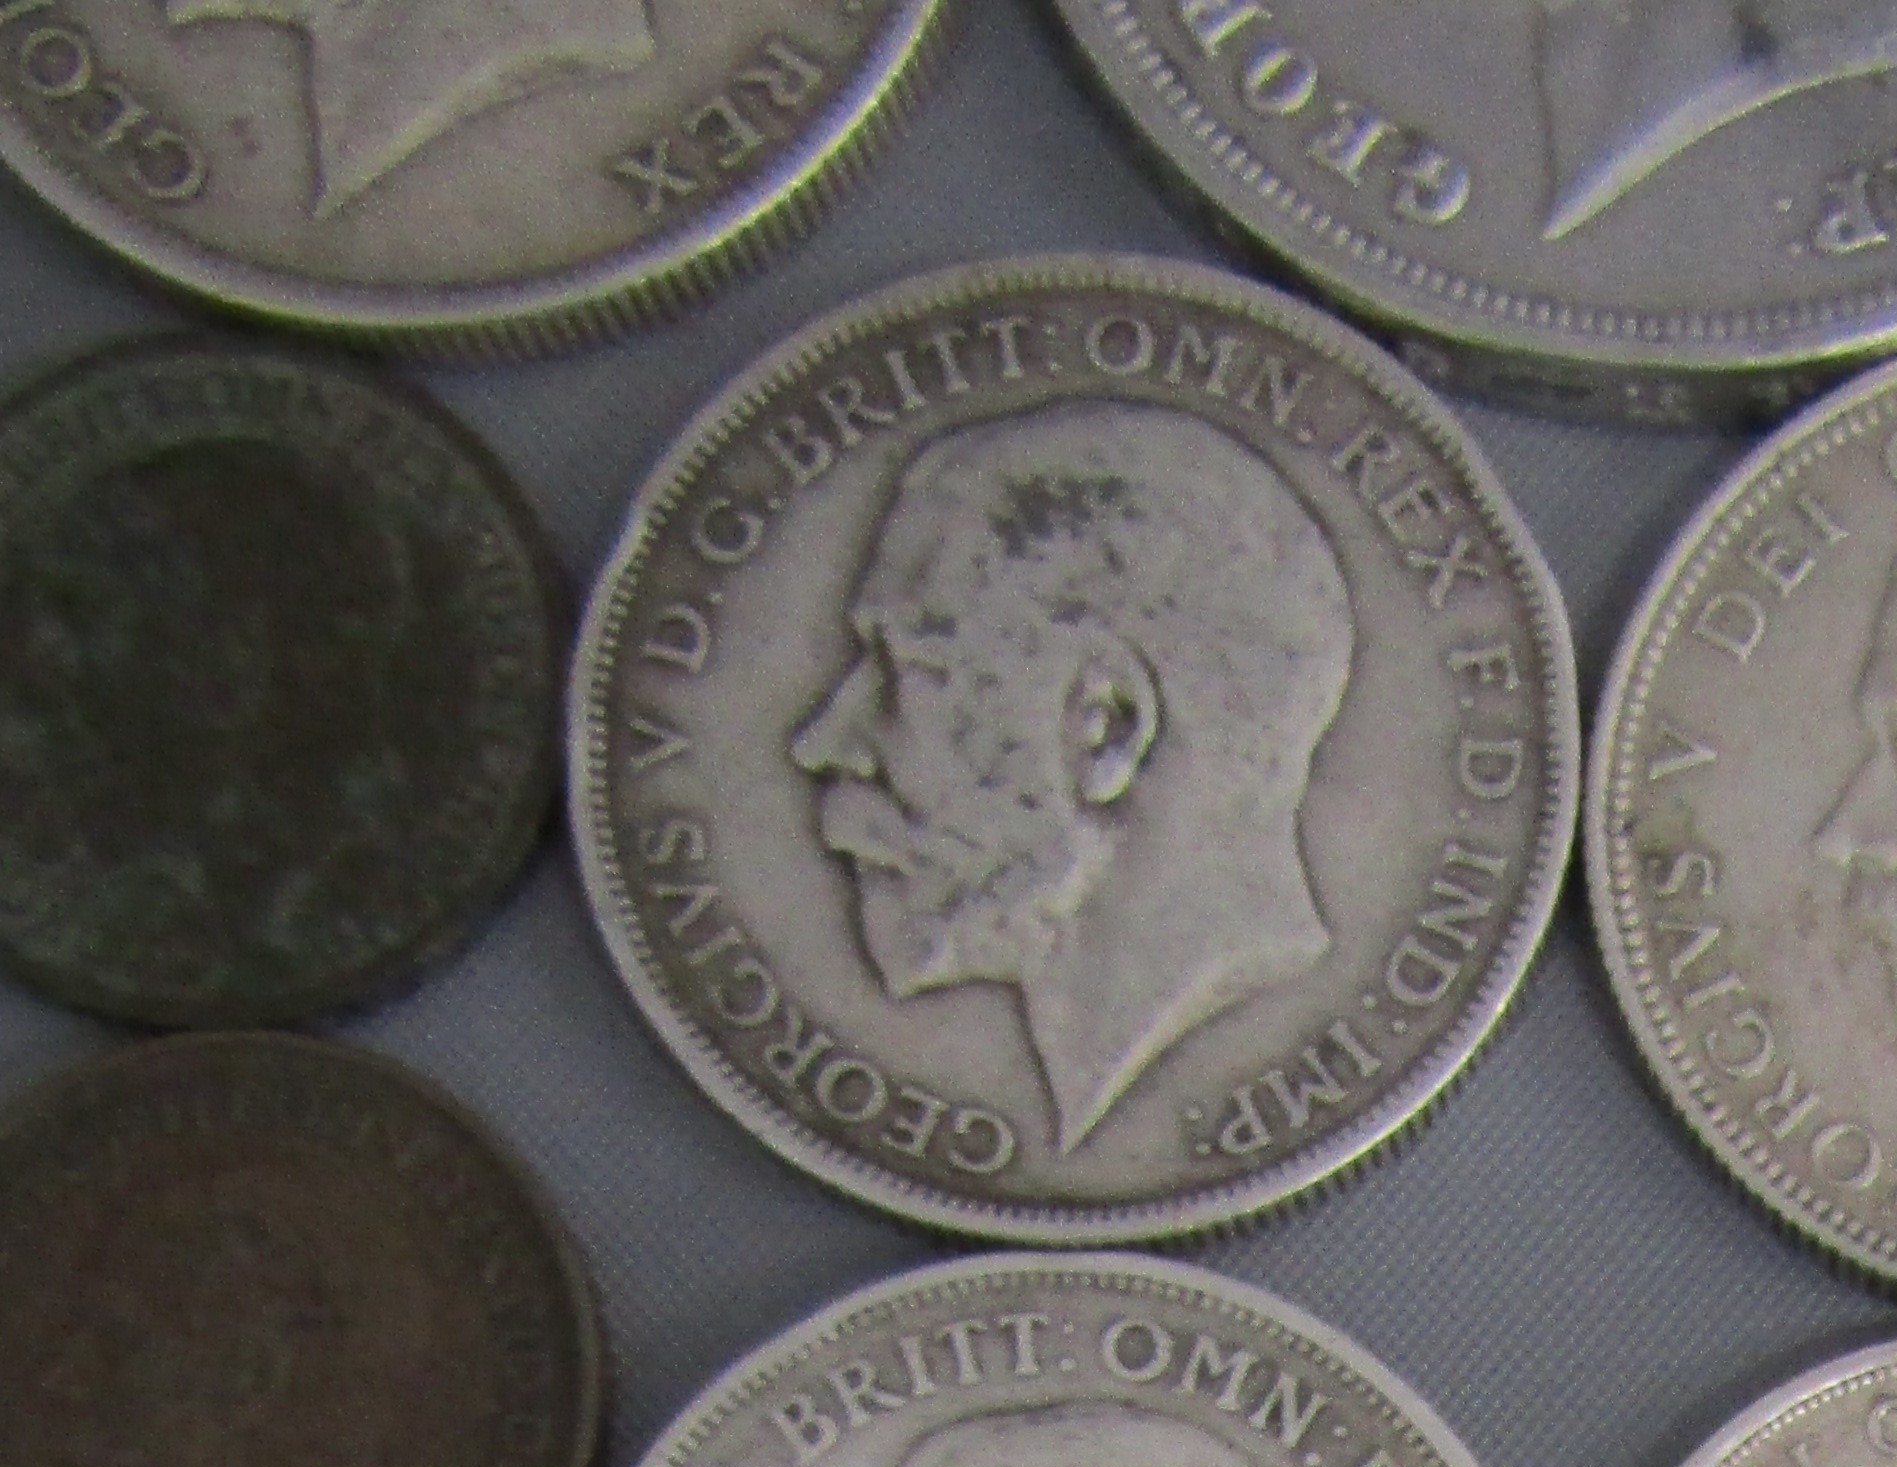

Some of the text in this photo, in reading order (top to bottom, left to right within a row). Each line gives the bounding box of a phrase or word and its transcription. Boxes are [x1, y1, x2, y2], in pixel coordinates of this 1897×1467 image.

[600, 38, 825, 215] REX
[1328, 426, 1491, 610] REX
[1647, 718, 1720, 784] V
[1692, 493, 1850, 666] DEI
[628, 714, 695, 771] V
[637, 818, 1022, 1177] GEORGIVS
